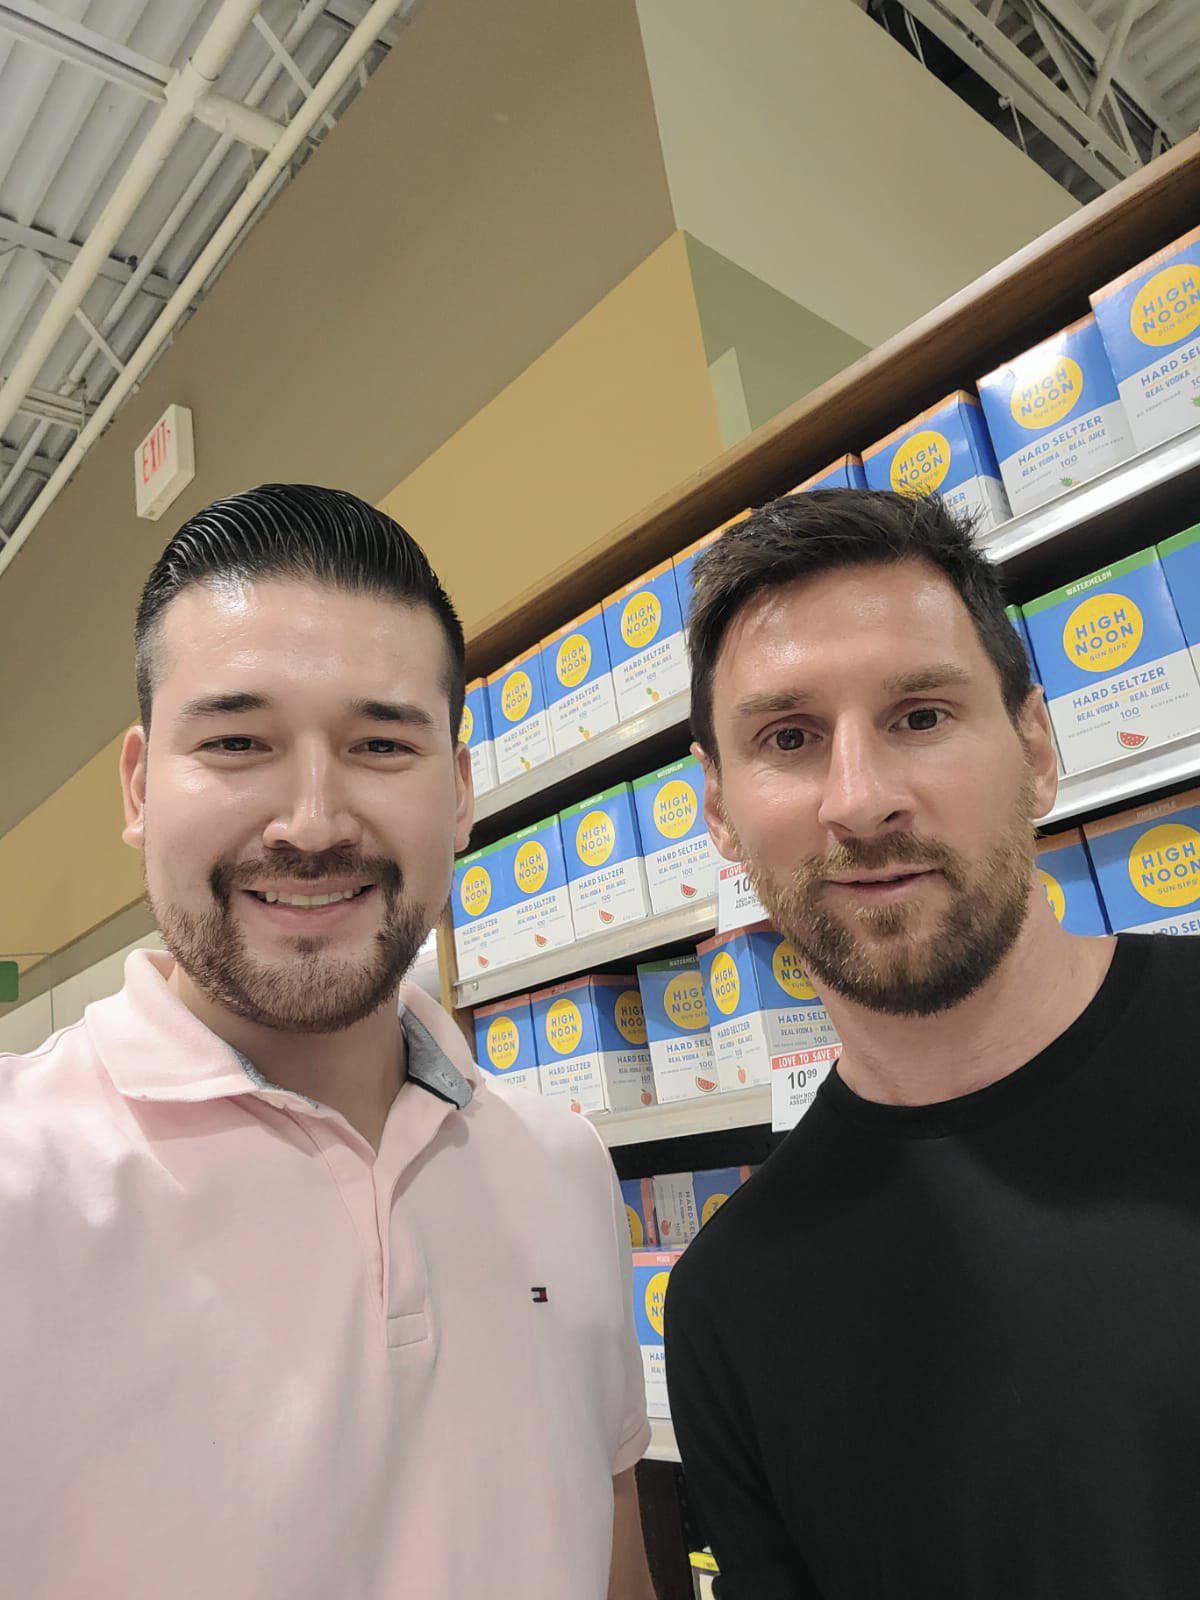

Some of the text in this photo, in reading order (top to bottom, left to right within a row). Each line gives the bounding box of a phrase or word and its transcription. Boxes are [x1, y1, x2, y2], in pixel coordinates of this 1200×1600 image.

[1142, 277, 1196, 318] HIGH
[1142, 289, 1200, 333] NOON
[1021, 367, 1067, 399] HIGH
[1140, 359, 1179, 387] HARD
[1021, 379, 1074, 417] NOON
[1018, 441, 1050, 466] HARD
[1052, 415, 1103, 446] SELTZER
[1068, 438, 1087, 451] REAL
[900, 442, 938, 474] HIGH
[1060, 455, 1078, 468] 100
[898, 454, 943, 488] NOON
[1066, 569, 1113, 596] WATERMELON
[626, 603, 654, 624] HIGH
[626, 612, 656, 636] NOON
[1074, 608, 1126, 641] HIGH
[1074, 622, 1134, 657] NOON
[560, 654, 587, 675] NOON
[561, 645, 585, 665] HIGH
[623, 643, 670, 673] HARD SELTZER
[506, 681, 526, 700] HIGH
[1072, 665, 1166, 709] HARD SELTZER
[505, 690, 528, 710] NOON
[1076, 681, 1171, 722] REAL VODKA REAL JUICE
[1119, 706, 1140, 720] 100
[659, 793, 689, 811] HIGH
[659, 805, 692, 825] NOON
[581, 823, 607, 841] HIGH
[581, 834, 611, 853] NOON
[656, 839, 708, 865] HARD SELTZER
[519, 853, 542, 869] HIGH
[1141, 841, 1196, 869] HIGH
[519, 862, 544, 881] NOON
[578, 867, 624, 891] HARD SELTZER
[1141, 858, 1200, 888] NOON
[465, 878, 486, 892] HIGH
[465, 887, 488, 904] NOON
[669, 955, 699, 967] WATERMEL
[714, 968, 733, 982] HIGH
[715, 980, 737, 996] NOON
[551, 1013, 575, 1027] HIGH
[777, 1013, 805, 1024] HARD
[491, 1029, 514, 1043] HIGH
[551, 1024, 578, 1039] NOON
[491, 1039, 515, 1054] NOON
[666, 1041, 692, 1053] HARD
[566, 1061, 591, 1074] SELTZER
[617, 1054, 637, 1064] HARD
[779, 1055, 796, 1068] LOVE
[800, 1053, 809, 1064] TO
[813, 1050, 831, 1062] SAVE
[685, 1191, 694, 1219] HARD
